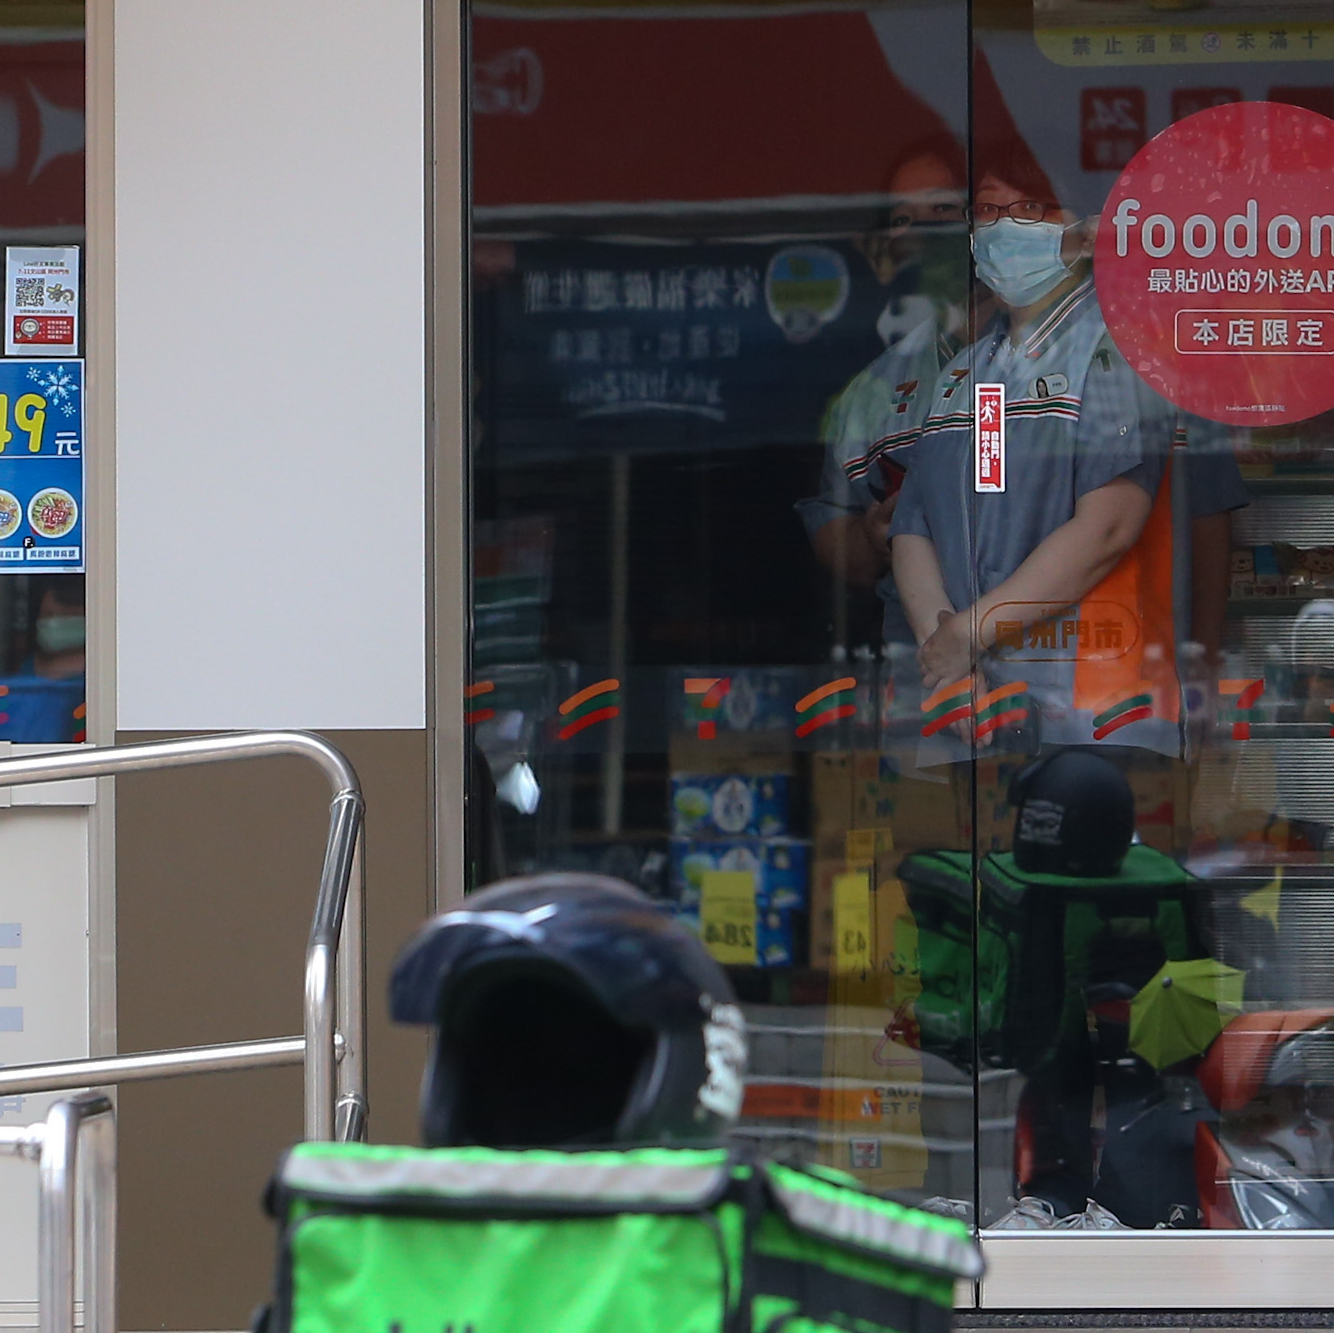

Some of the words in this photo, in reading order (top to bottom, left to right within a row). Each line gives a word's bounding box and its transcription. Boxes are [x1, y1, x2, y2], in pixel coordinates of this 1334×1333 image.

[1071, 33, 1189, 57] 禁止酒駕
[1192, 318, 1325, 348] 本店限定
[54, 432, 81, 456] 元
